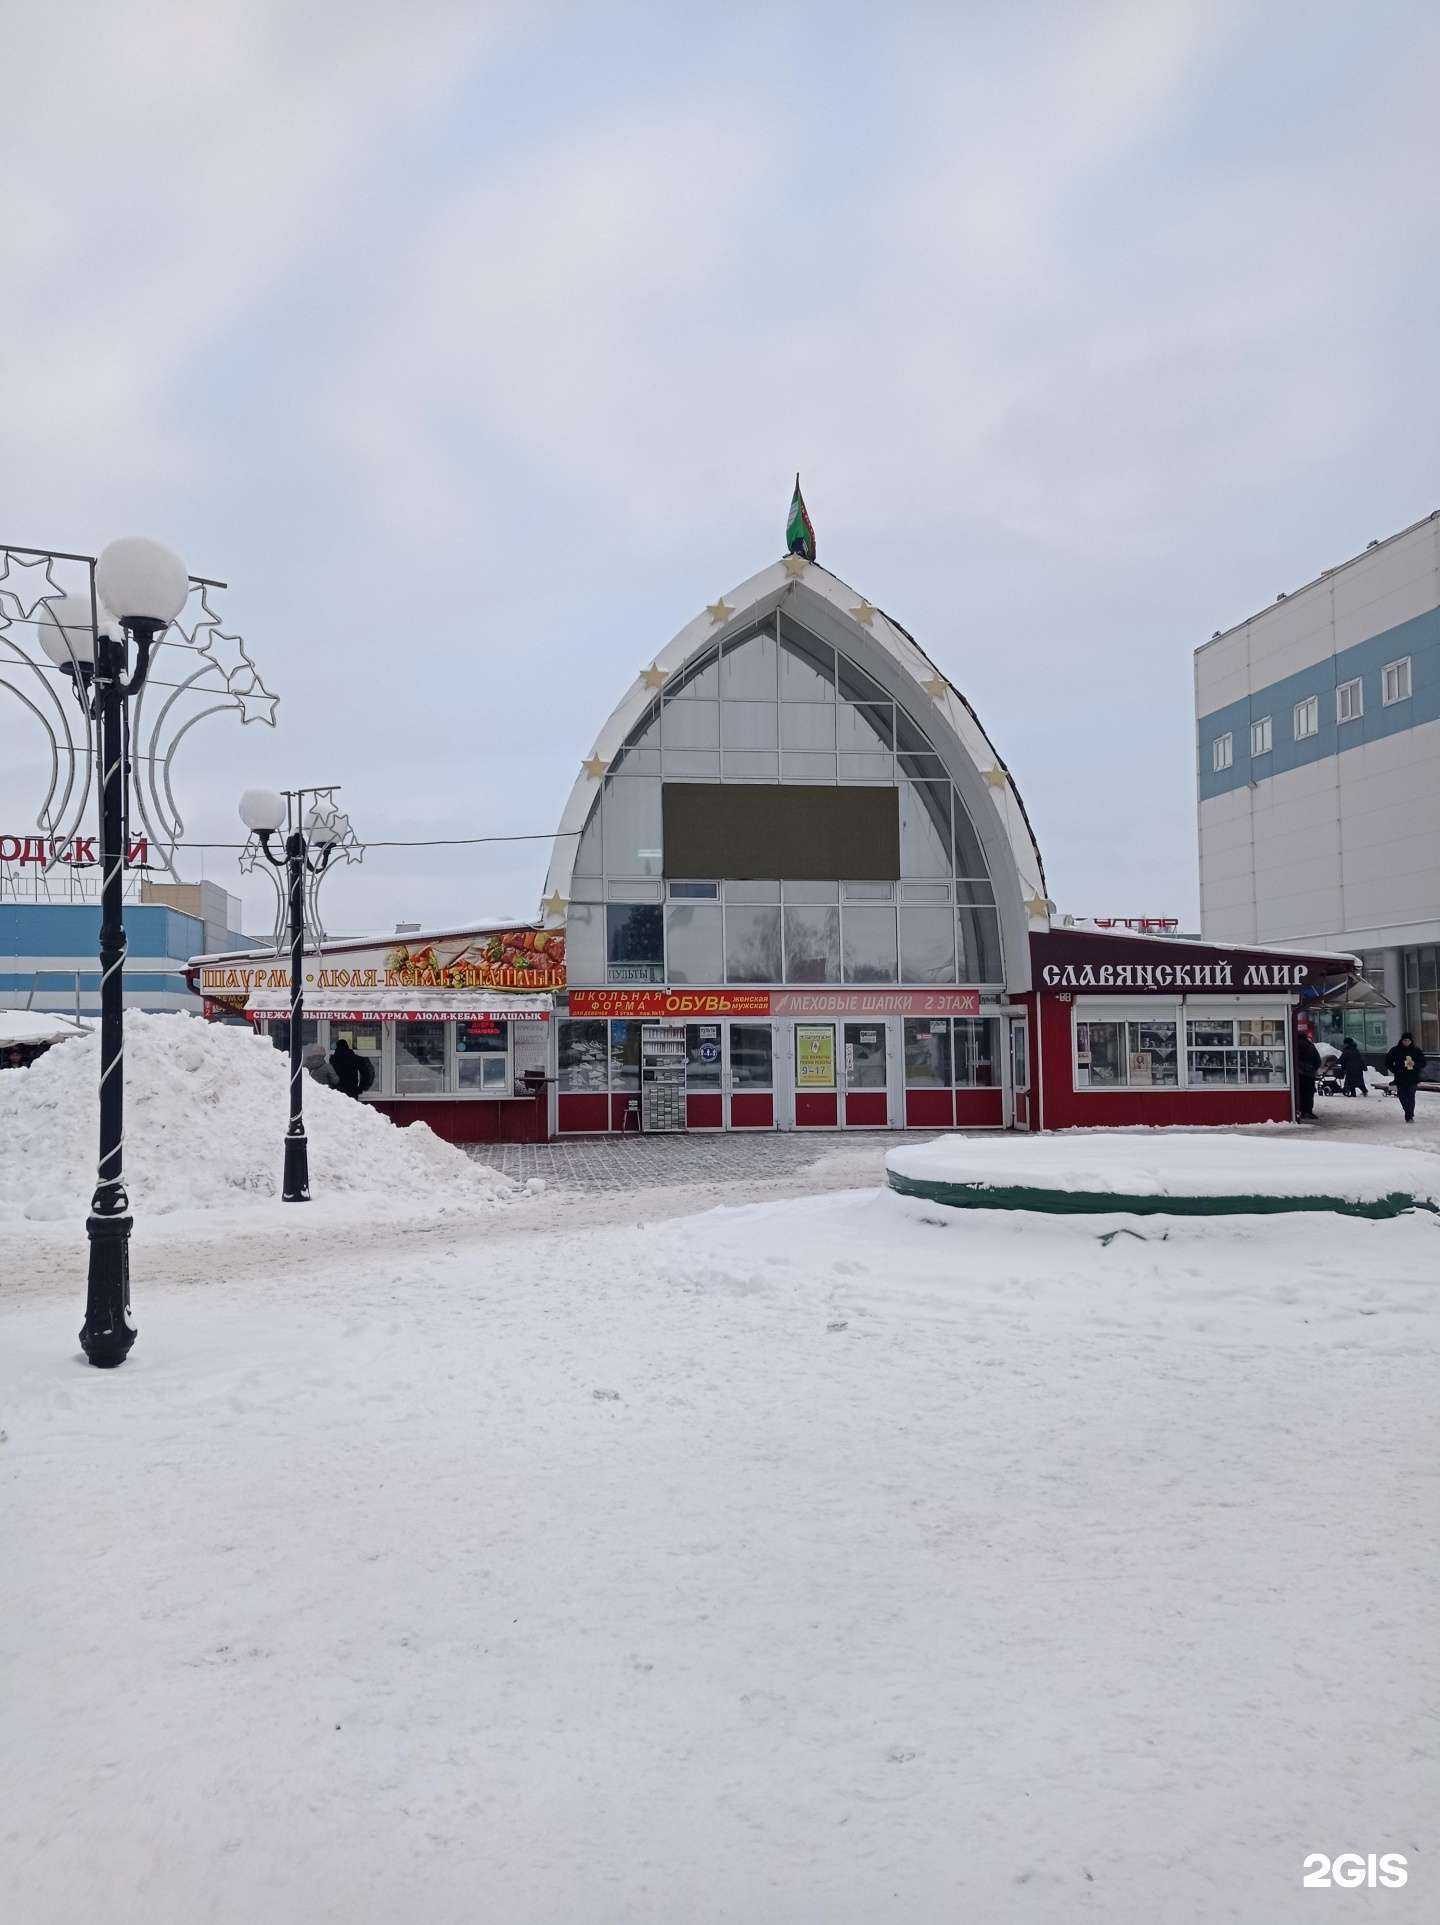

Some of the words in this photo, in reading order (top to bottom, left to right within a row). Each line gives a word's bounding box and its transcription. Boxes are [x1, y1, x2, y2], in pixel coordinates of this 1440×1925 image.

[0, 832, 148, 867] ОДСКЙ
[203, 969, 294, 992] ШАУРМ
[1042, 961, 1233, 987] СЛАВЯНСКИЙ
[1243, 964, 1309, 986] МИР
[574, 991, 662, 1001] ШКОЛЬНАЯ
[791, 996, 858, 1010] МЕХОВЫЕ
[862, 996, 912, 1010] ШАПКИ
[925, 996, 934, 1010] 2
[939, 996, 974, 1010] ЭТАЖ
[591, 1001, 646, 1010] ФОРМА
[666, 996, 732, 1011] ОБУВЬ
[253, 1011, 293, 1020] СВЕЖА
[303, 1011, 356, 1020] ВЫПЕЧКА
[362, 1011, 409, 1020] ШАУРМА
[489, 1011, 542, 1020] ШАШЛЫК
